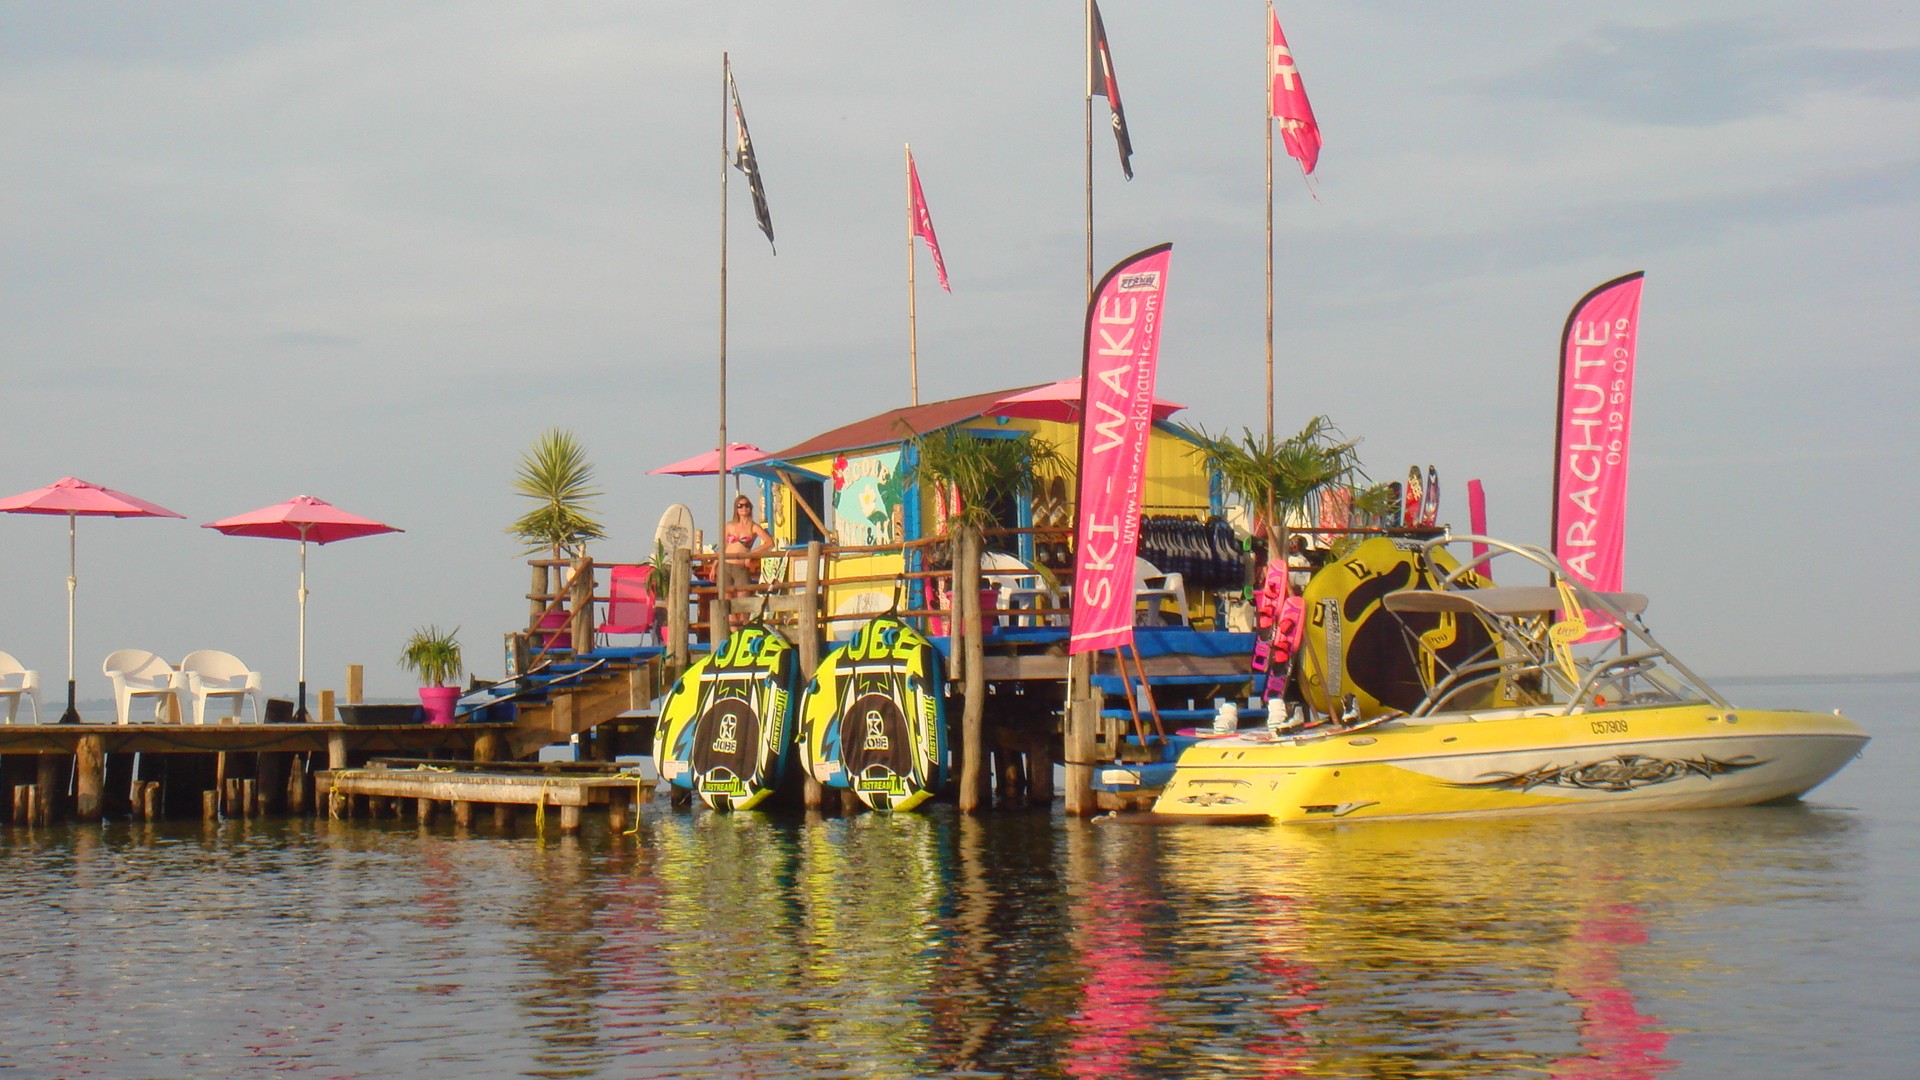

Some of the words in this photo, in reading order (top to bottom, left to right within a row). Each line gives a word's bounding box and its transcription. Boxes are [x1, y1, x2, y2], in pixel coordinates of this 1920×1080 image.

[1614, 318, 1630, 340] 19
[1612, 347, 1629, 373] 09
[1093, 296, 1137, 455] WAKE
[1609, 379, 1626, 405] 55
[1608, 411, 1624, 433] 19
[1566, 321, 1611, 590] ARACHUTE
[1605, 440, 1623, 466] 06
[867, 526, 874, 545] &
[1083, 513, 1119, 610] SKI
[772, 705, 784, 751] AIRSTREAM
[927, 712, 937, 761] AIRSTREAM
[1591, 720, 1628, 734] C57909
[713, 738, 737, 754] JOBE
[864, 736, 889, 750] OBE
